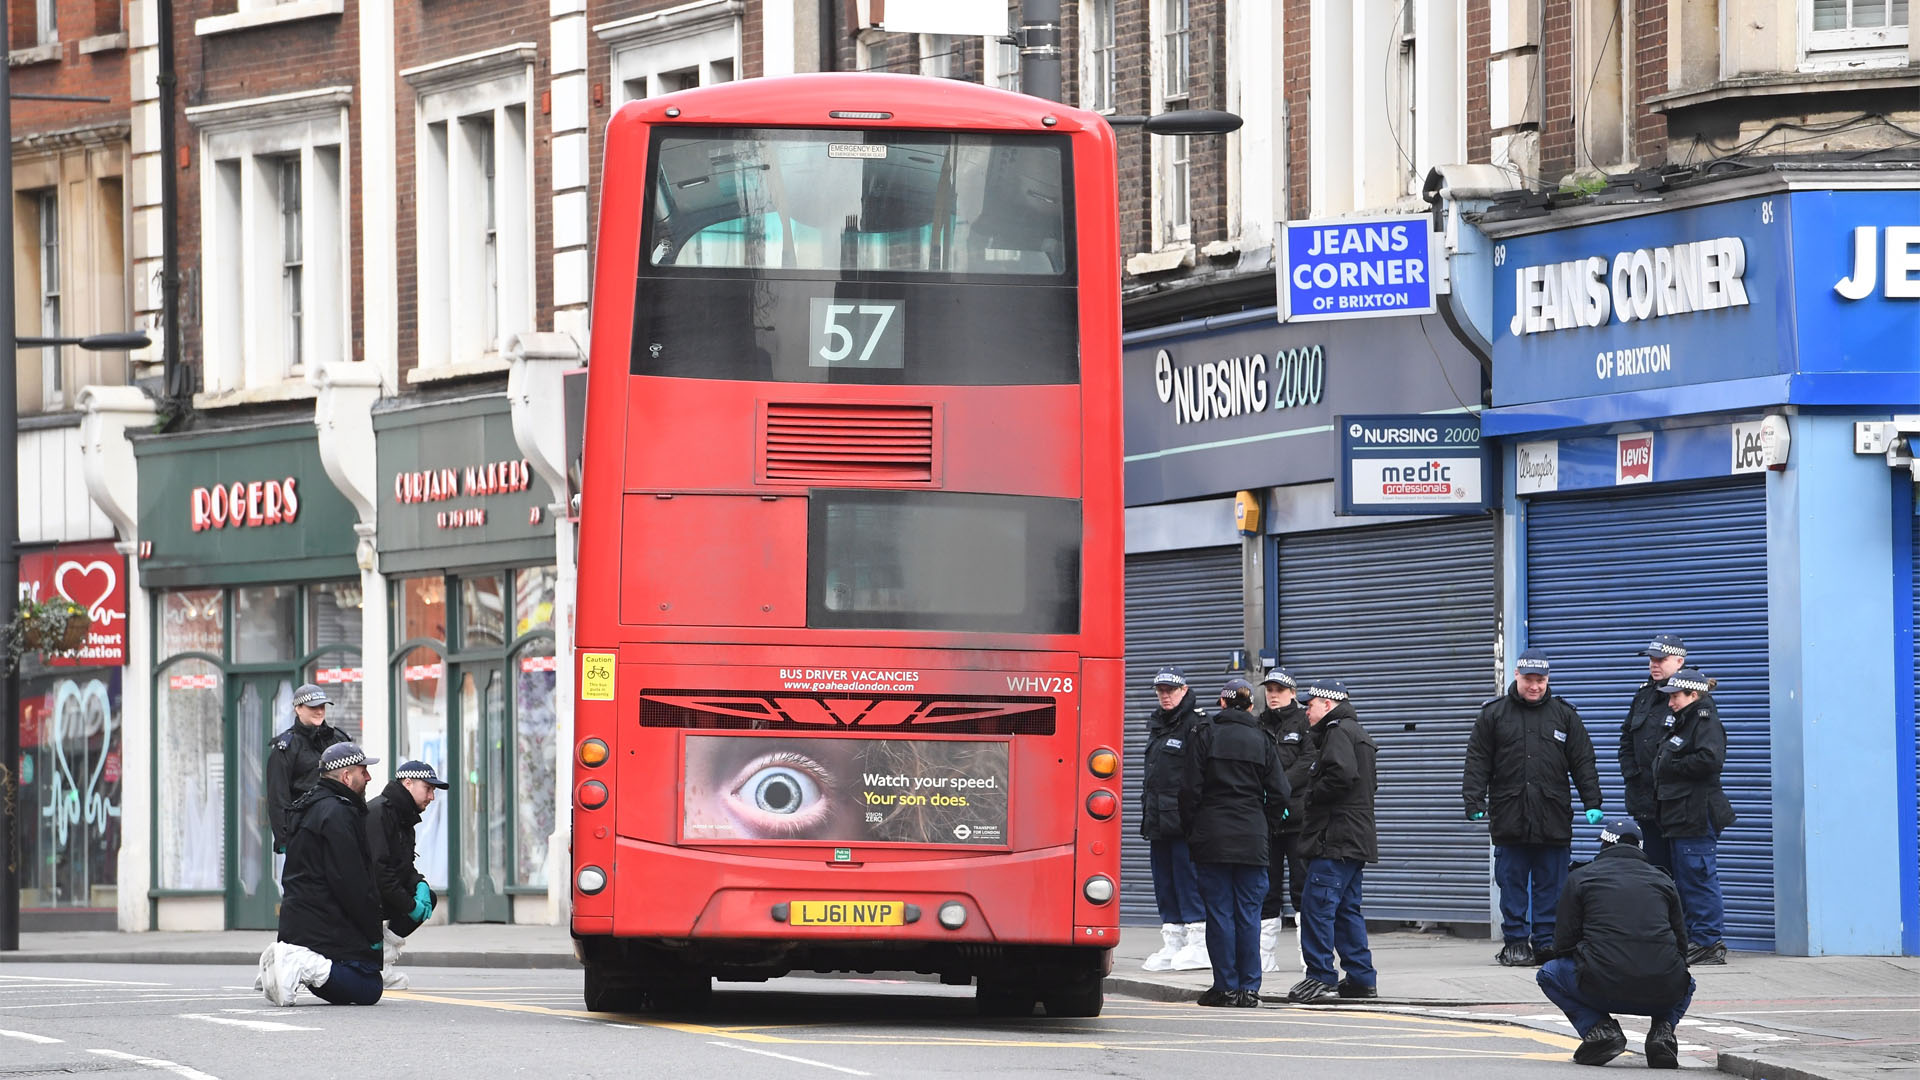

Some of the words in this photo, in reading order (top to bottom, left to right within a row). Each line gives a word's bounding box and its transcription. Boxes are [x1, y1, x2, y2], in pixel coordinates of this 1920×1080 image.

[1307, 225, 1409, 256] JEANS
[1494, 244, 1506, 267] 89
[1292, 258, 1425, 290] CORNER
[1510, 256, 1611, 337] JEANS
[1612, 236, 1750, 323] CORNER
[1312, 296, 1334, 310] OF
[1339, 292, 1408, 309] BRIXTON
[819, 305, 896, 361] 57
[1596, 351, 1615, 380] OF
[1616, 343, 1671, 377] BRIXTON
[1174, 353, 1267, 425] NURSING
[1274, 344, 1322, 409] 2000
[1364, 428, 1438, 443] NURSING
[1444, 428, 1480, 443] 2000
[1736, 428, 1763, 469] Lee
[1382, 461, 1451, 482] medic
[1518, 448, 1555, 488] Wrangler
[395, 467, 458, 504] CURTAIN
[464, 458, 529, 497] MAKERS
[1386, 483, 1447, 495] professionals
[191, 476, 298, 532] ROGERS
[88, 632, 122, 644] Heart
[780, 669, 802, 679] BUS
[805, 670, 848, 681] DRIVER
[851, 671, 919, 682] VACANCIES
[1006, 675, 1073, 693] WHV28
[784, 681, 915, 693] www.goaheadlondon.com
[863, 773, 910, 787] Watch
[914, 777, 949, 790] your
[950, 776, 998, 790] speed.
[864, 792, 897, 805] Your
[899, 794, 926, 806] son
[930, 793, 970, 807] does.
[803, 904, 846, 923] LJ61
[853, 904, 892, 923] NVP
